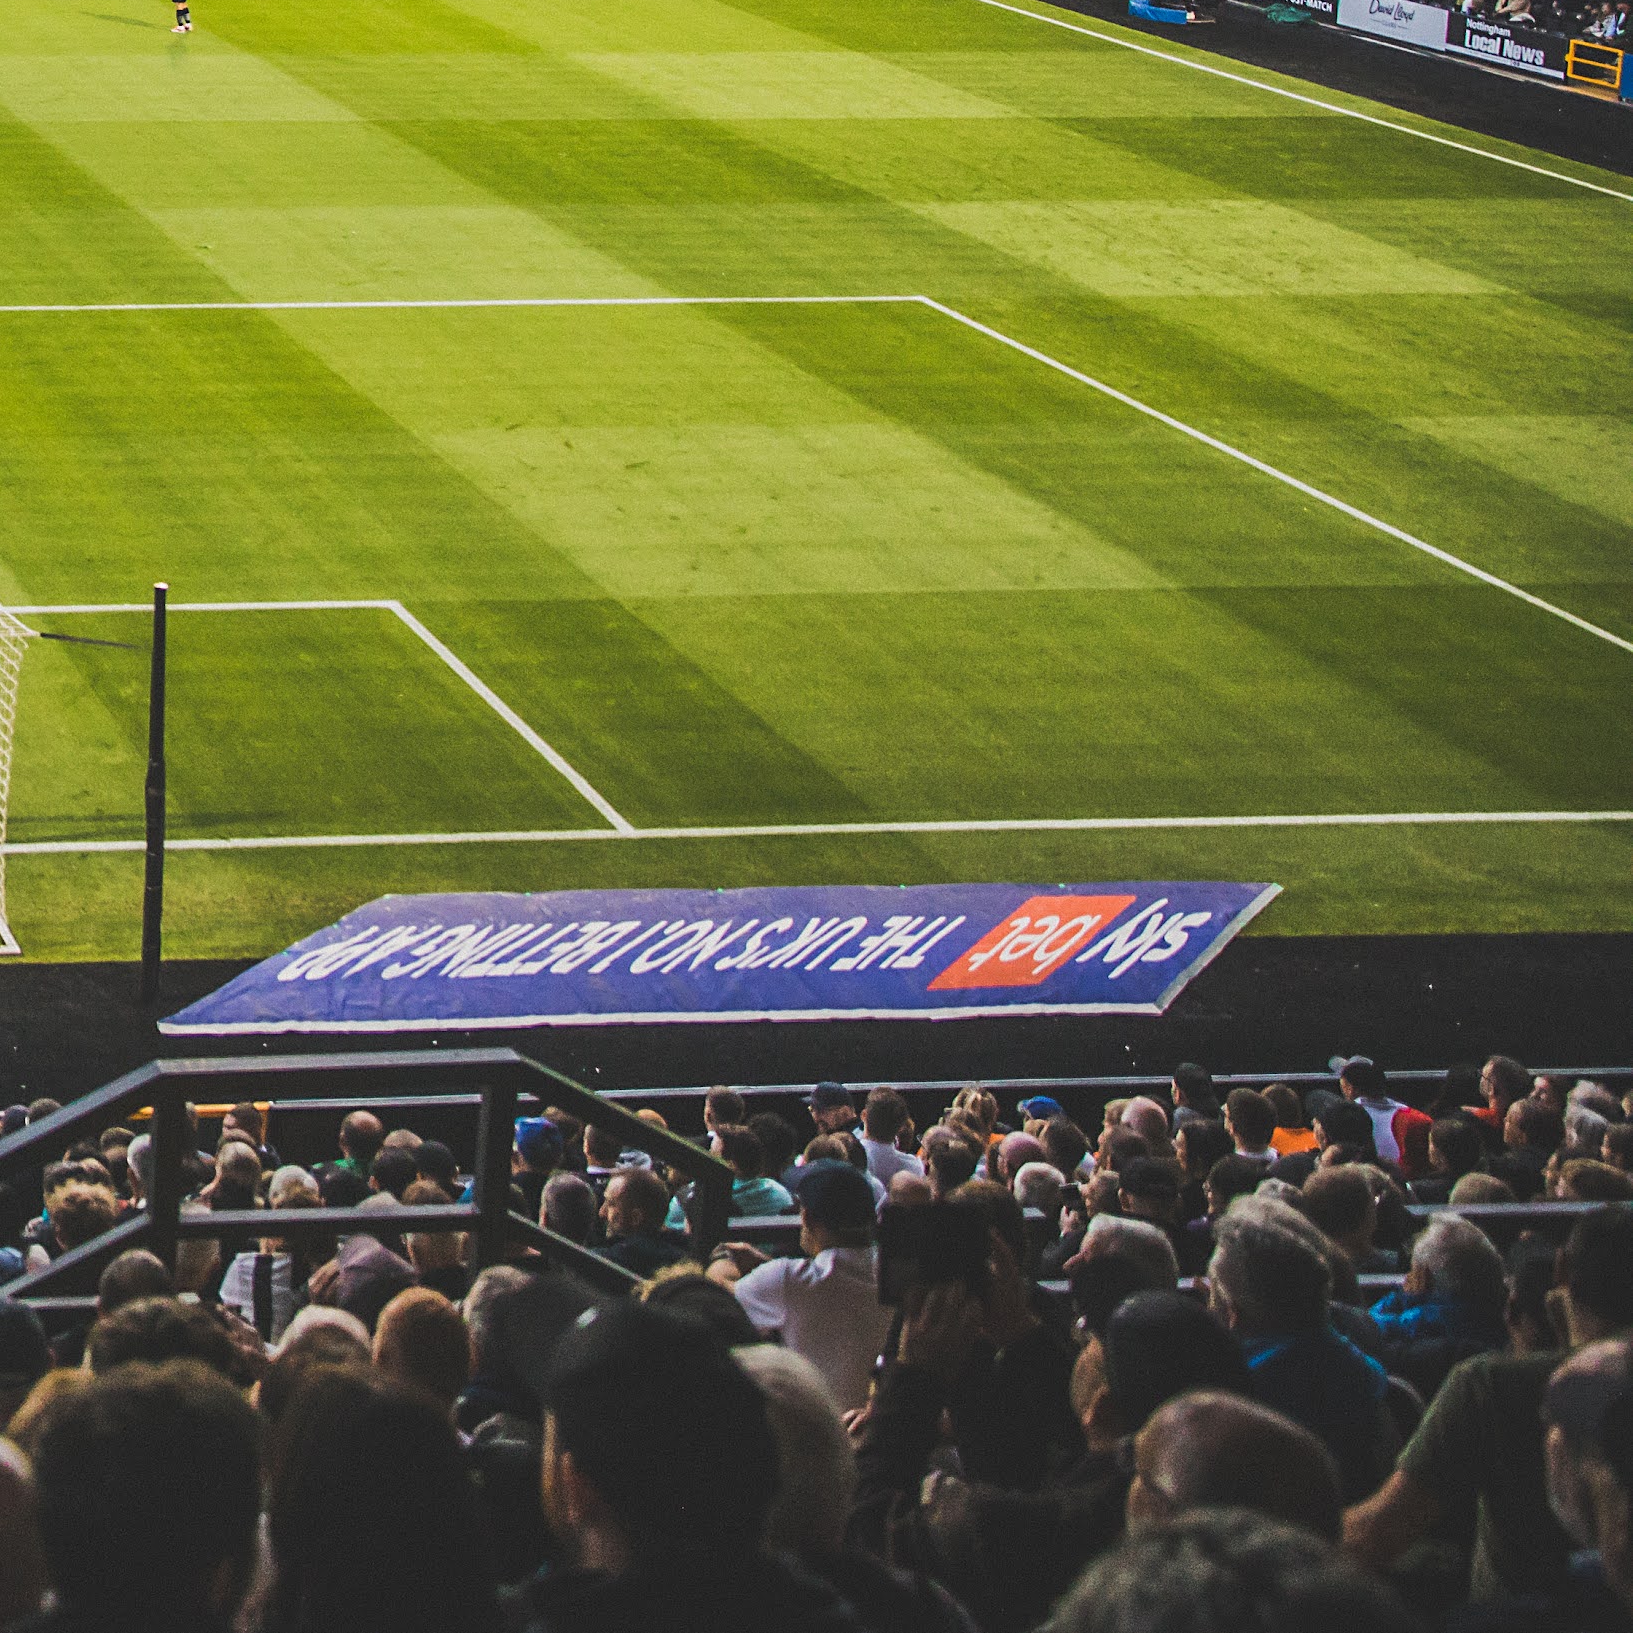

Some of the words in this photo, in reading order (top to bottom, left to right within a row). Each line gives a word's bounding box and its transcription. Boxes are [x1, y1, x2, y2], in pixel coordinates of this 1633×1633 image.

[1393, 2, 1415, 22] Lloyd
[1467, 18, 1511, 38] Nottingham
[1465, 30, 1500, 55] Local
[1502, 39, 1545, 66] News
[275, 924, 442, 980] APP
[376, 920, 640, 978] BETTING
[711, 917, 869, 972] UK'S
[827, 915, 967, 970] THE
[961, 914, 1103, 973] bet
[1073, 898, 1214, 978] sky
